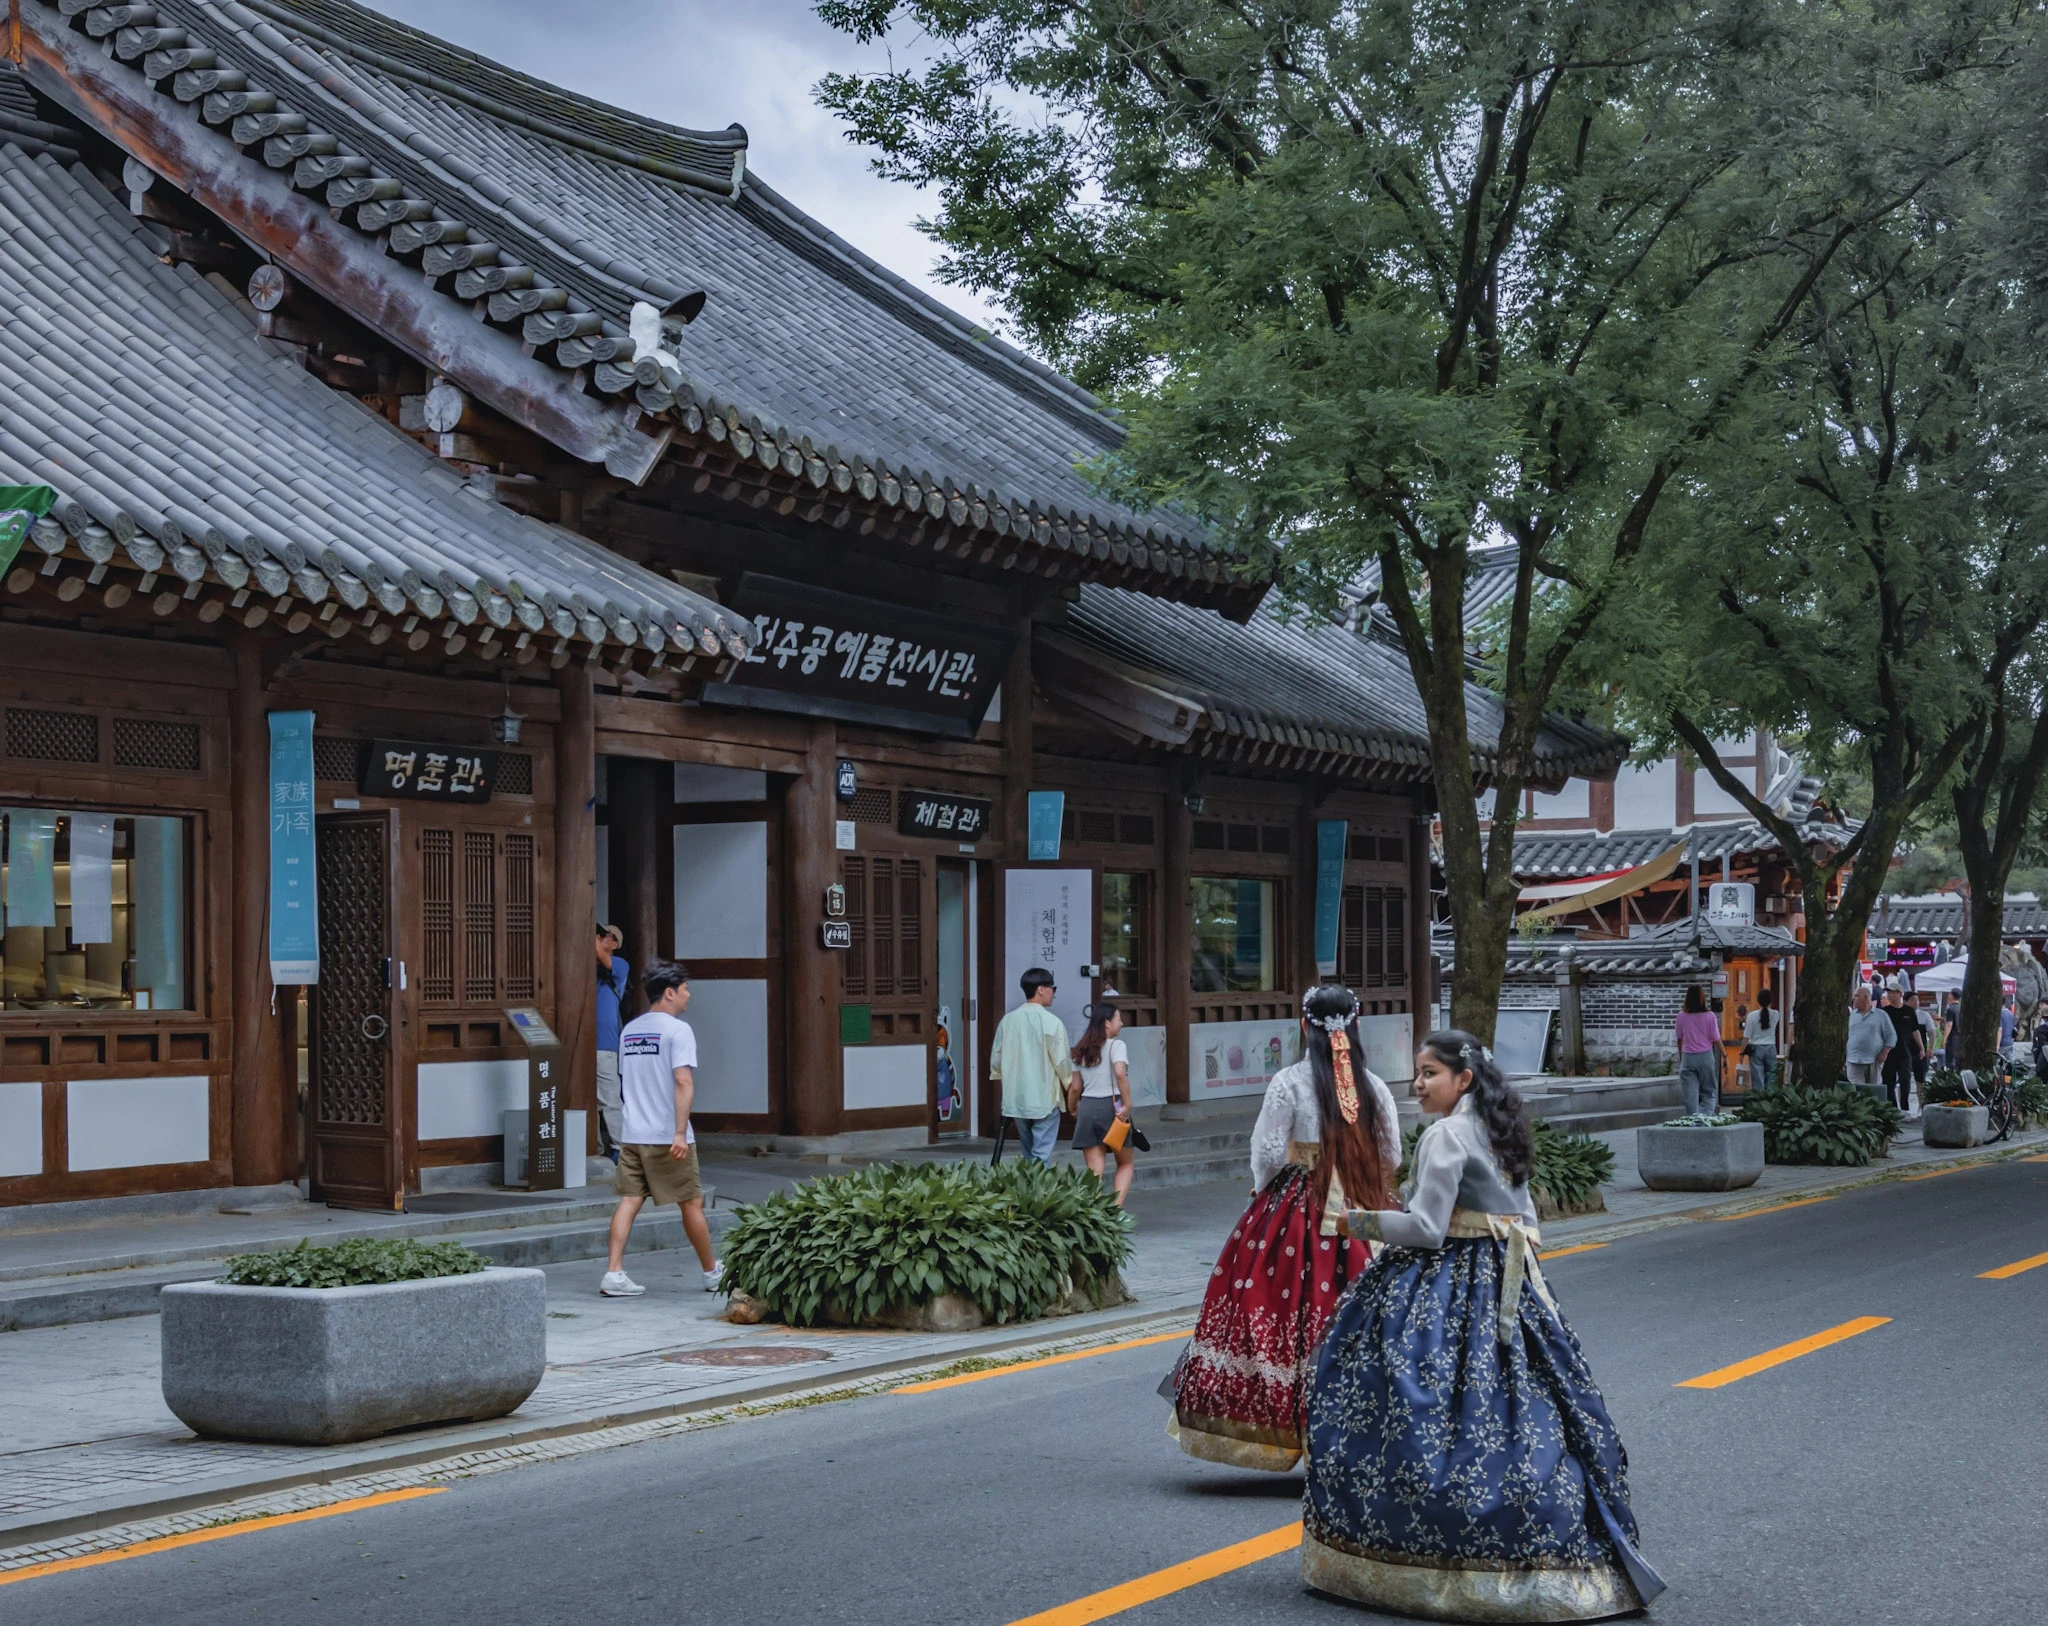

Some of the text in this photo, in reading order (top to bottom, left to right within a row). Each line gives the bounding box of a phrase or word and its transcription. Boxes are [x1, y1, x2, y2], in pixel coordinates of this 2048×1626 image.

[744, 614, 976, 697] 전주공예품전시관
[385, 751, 483, 793] 명품관
[840, 773, 854, 787] ADT
[274, 781, 309, 802] 家族
[274, 812, 310, 836] 가족
[915, 801, 980, 832] 체험관
[832, 899, 840, 909] 15
[832, 929, 848, 940] 수유실
[1041, 908, 1056, 962] 체험관
[538, 1060, 551, 1140] 명품관
